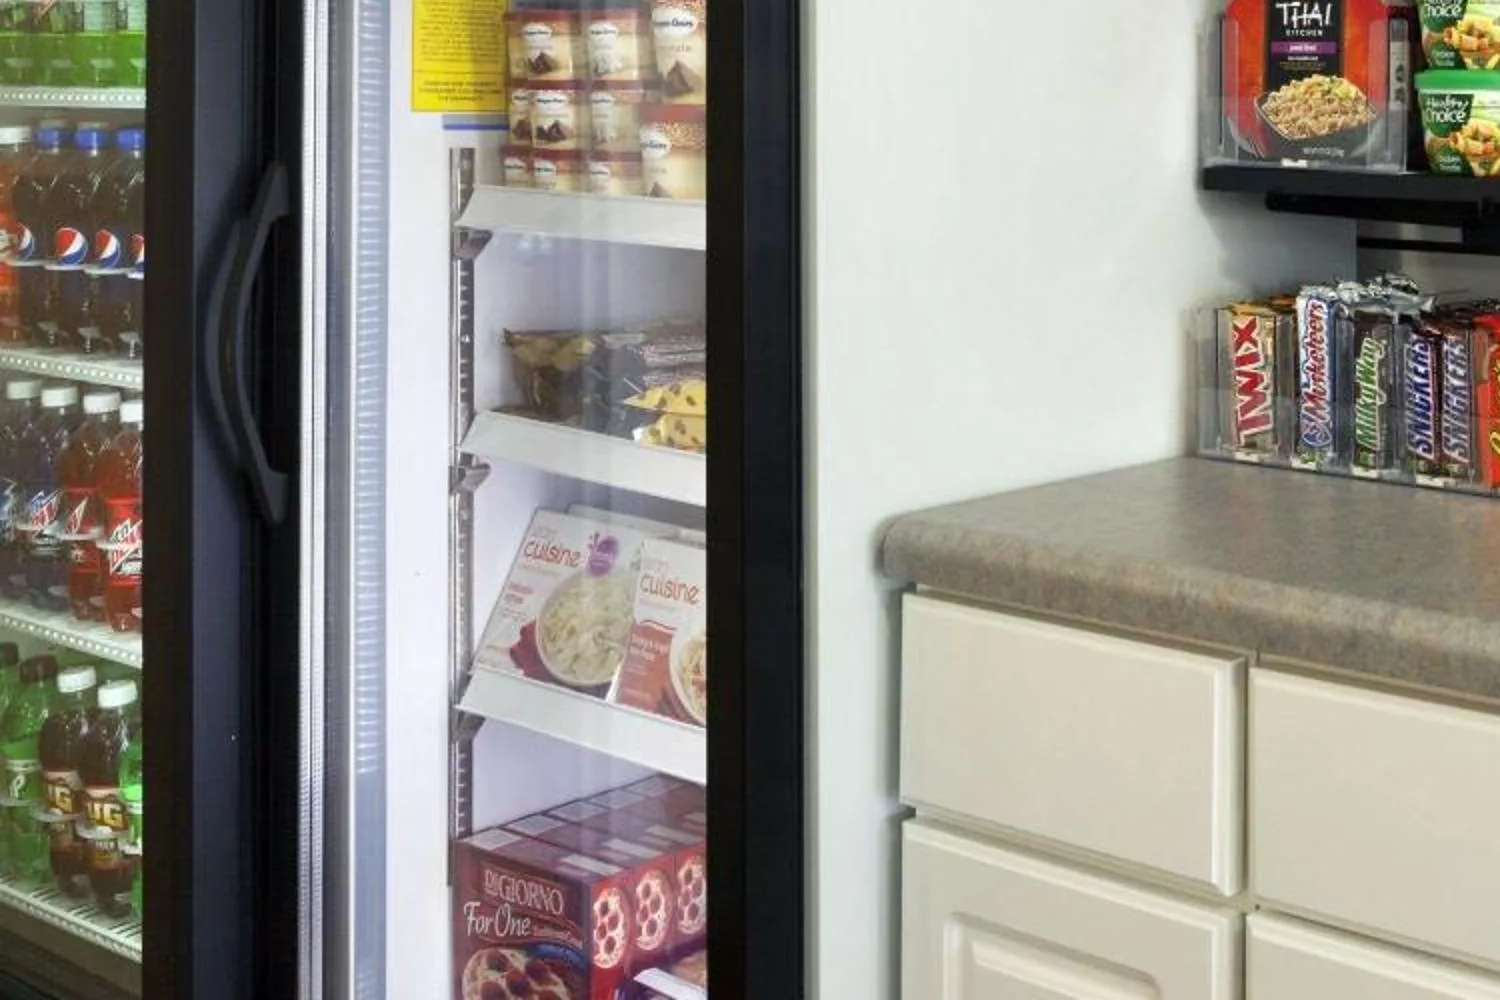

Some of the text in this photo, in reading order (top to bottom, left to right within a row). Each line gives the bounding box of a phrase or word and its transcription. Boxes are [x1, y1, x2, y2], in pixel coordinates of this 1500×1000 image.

[1274, 1, 1334, 29] THAI
[1231, 315, 1273, 446] TWIX
[1302, 299, 1329, 425] Musketeers
[1404, 333, 1436, 460] SNICKERS
[1442, 337, 1470, 463] SNICKERS
[523, 538, 582, 569] cuisine
[640, 574, 700, 605] cuisine
[464, 899, 496, 937] For
[492, 902, 532, 938] One
